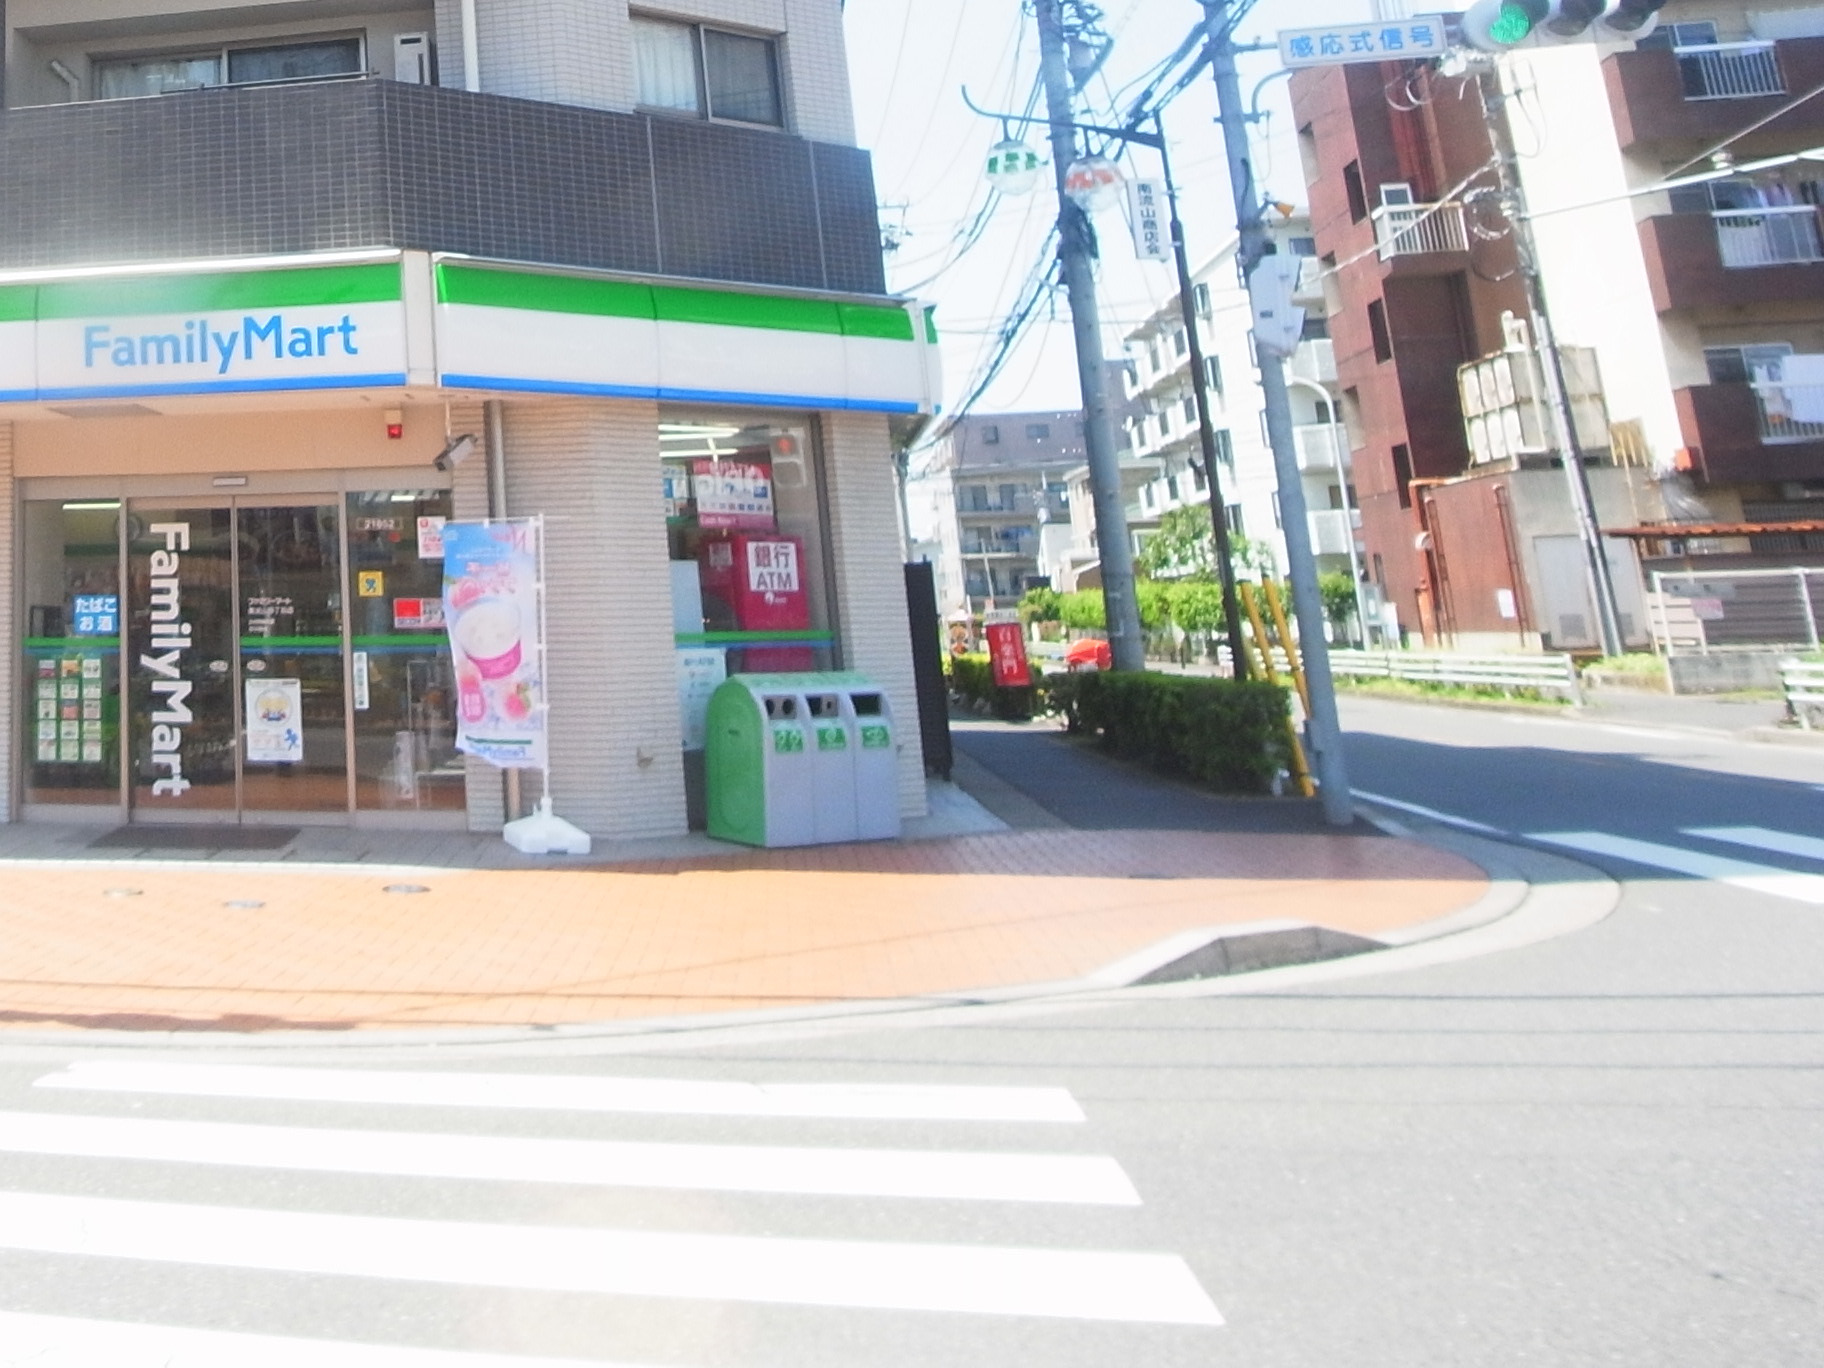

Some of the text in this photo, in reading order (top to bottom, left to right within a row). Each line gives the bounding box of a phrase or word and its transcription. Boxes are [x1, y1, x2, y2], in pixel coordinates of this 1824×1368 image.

[1290, 25, 1433, 58] 感応式信号
[84, 314, 358, 374] FamilyMart
[755, 545, 790, 568] 銀行
[756, 572, 792, 589] ATM
[76, 597, 117, 613] たばこ
[79, 615, 113, 631] お酒
[140, 522, 194, 797] FamilyMart
